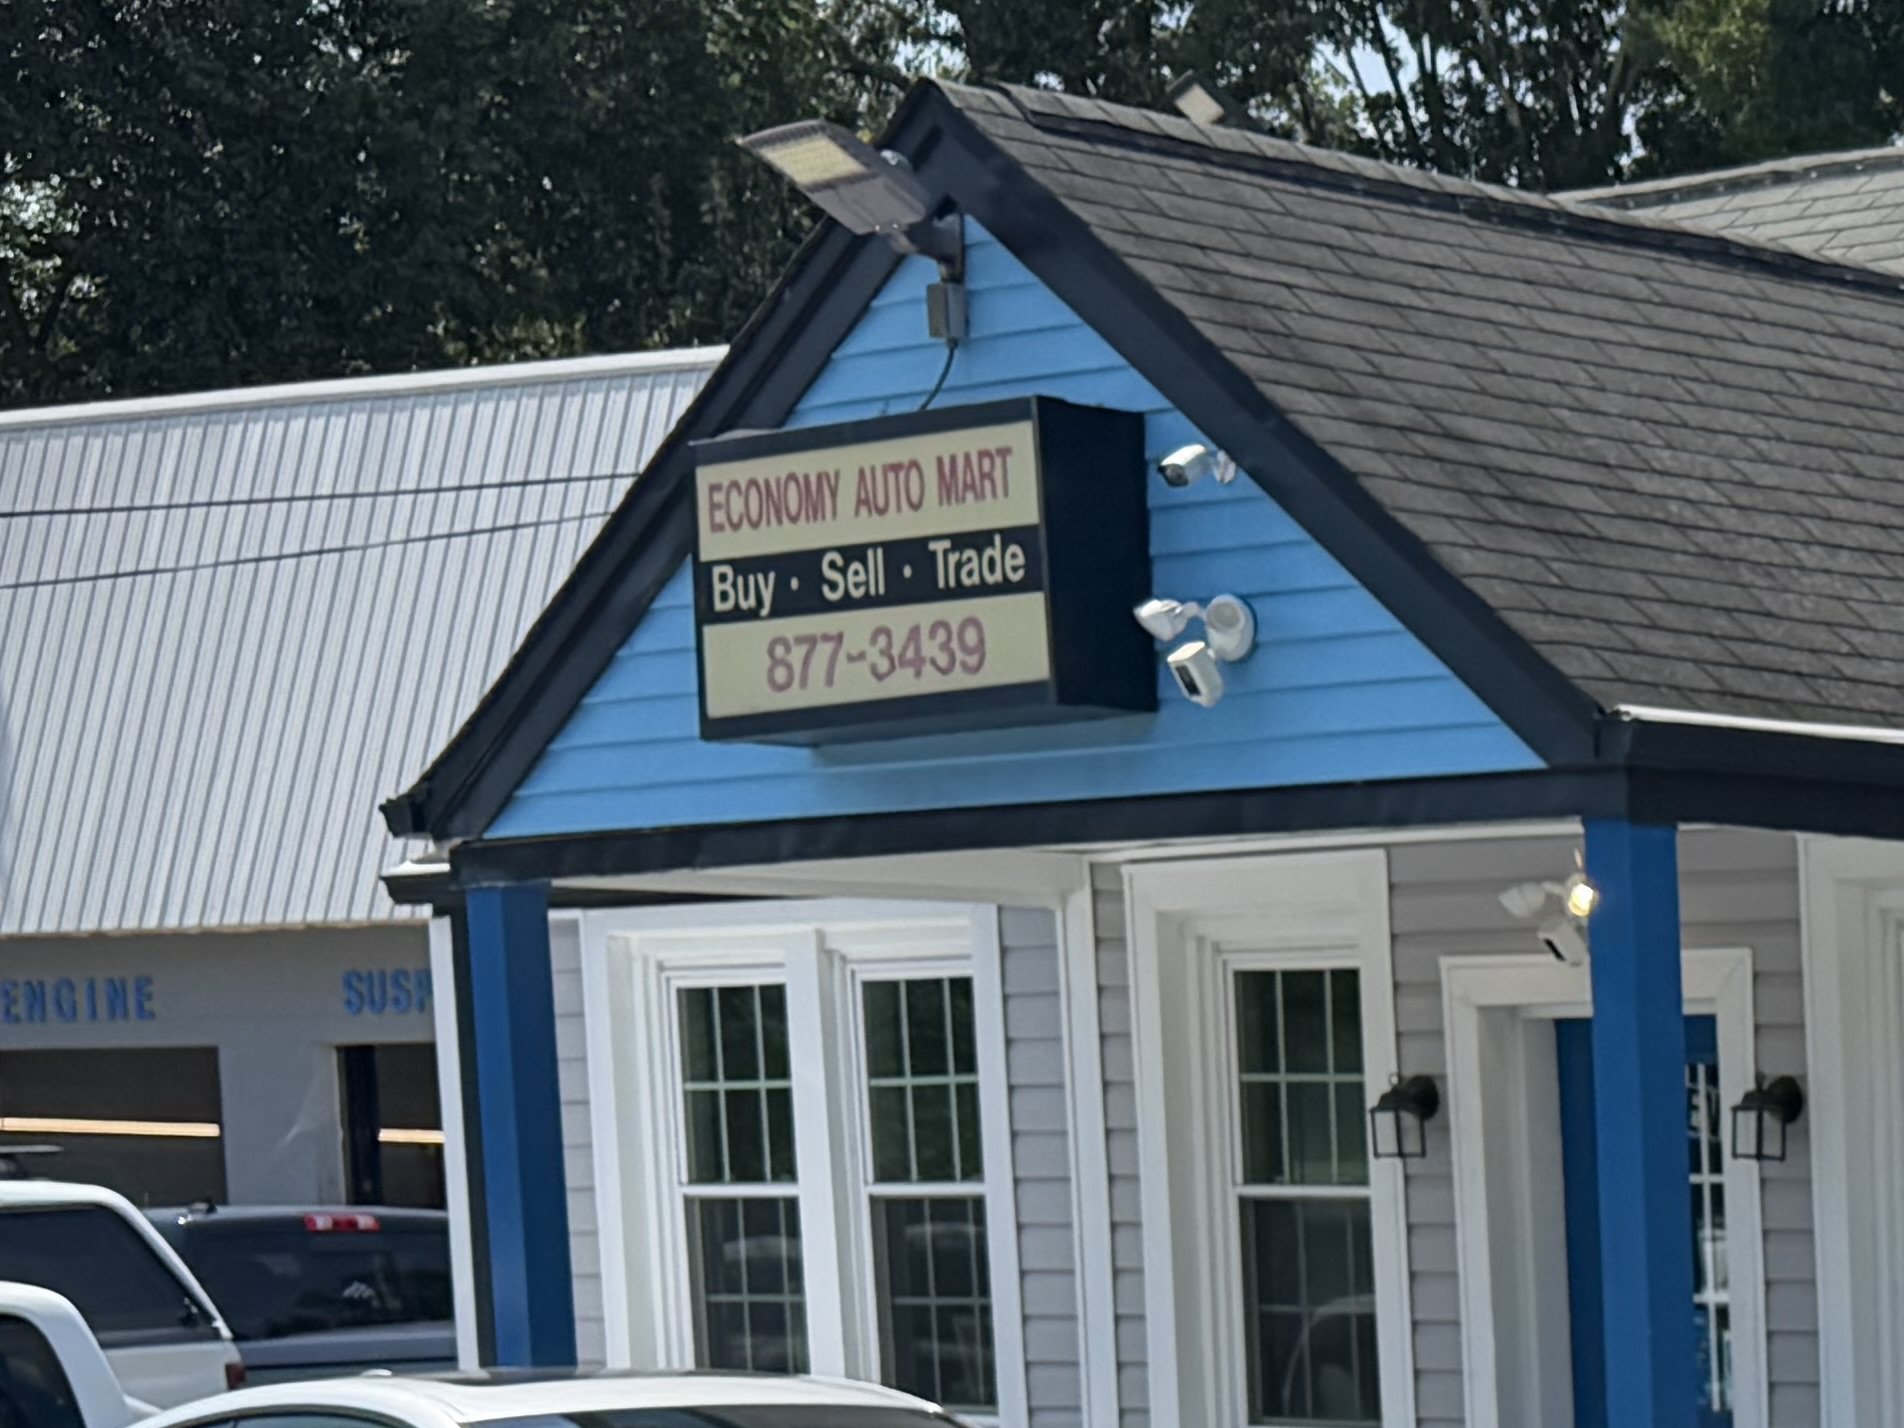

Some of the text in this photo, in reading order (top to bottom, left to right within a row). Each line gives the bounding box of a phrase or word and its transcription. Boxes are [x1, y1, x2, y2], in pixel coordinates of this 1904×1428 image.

[708, 447, 1013, 534] ECONOMY AUTO MART
[711, 532, 1026, 617] Buy Sell Trade
[766, 615, 987, 693] 877-3439
[1, 974, 156, 1024] ENGINE
